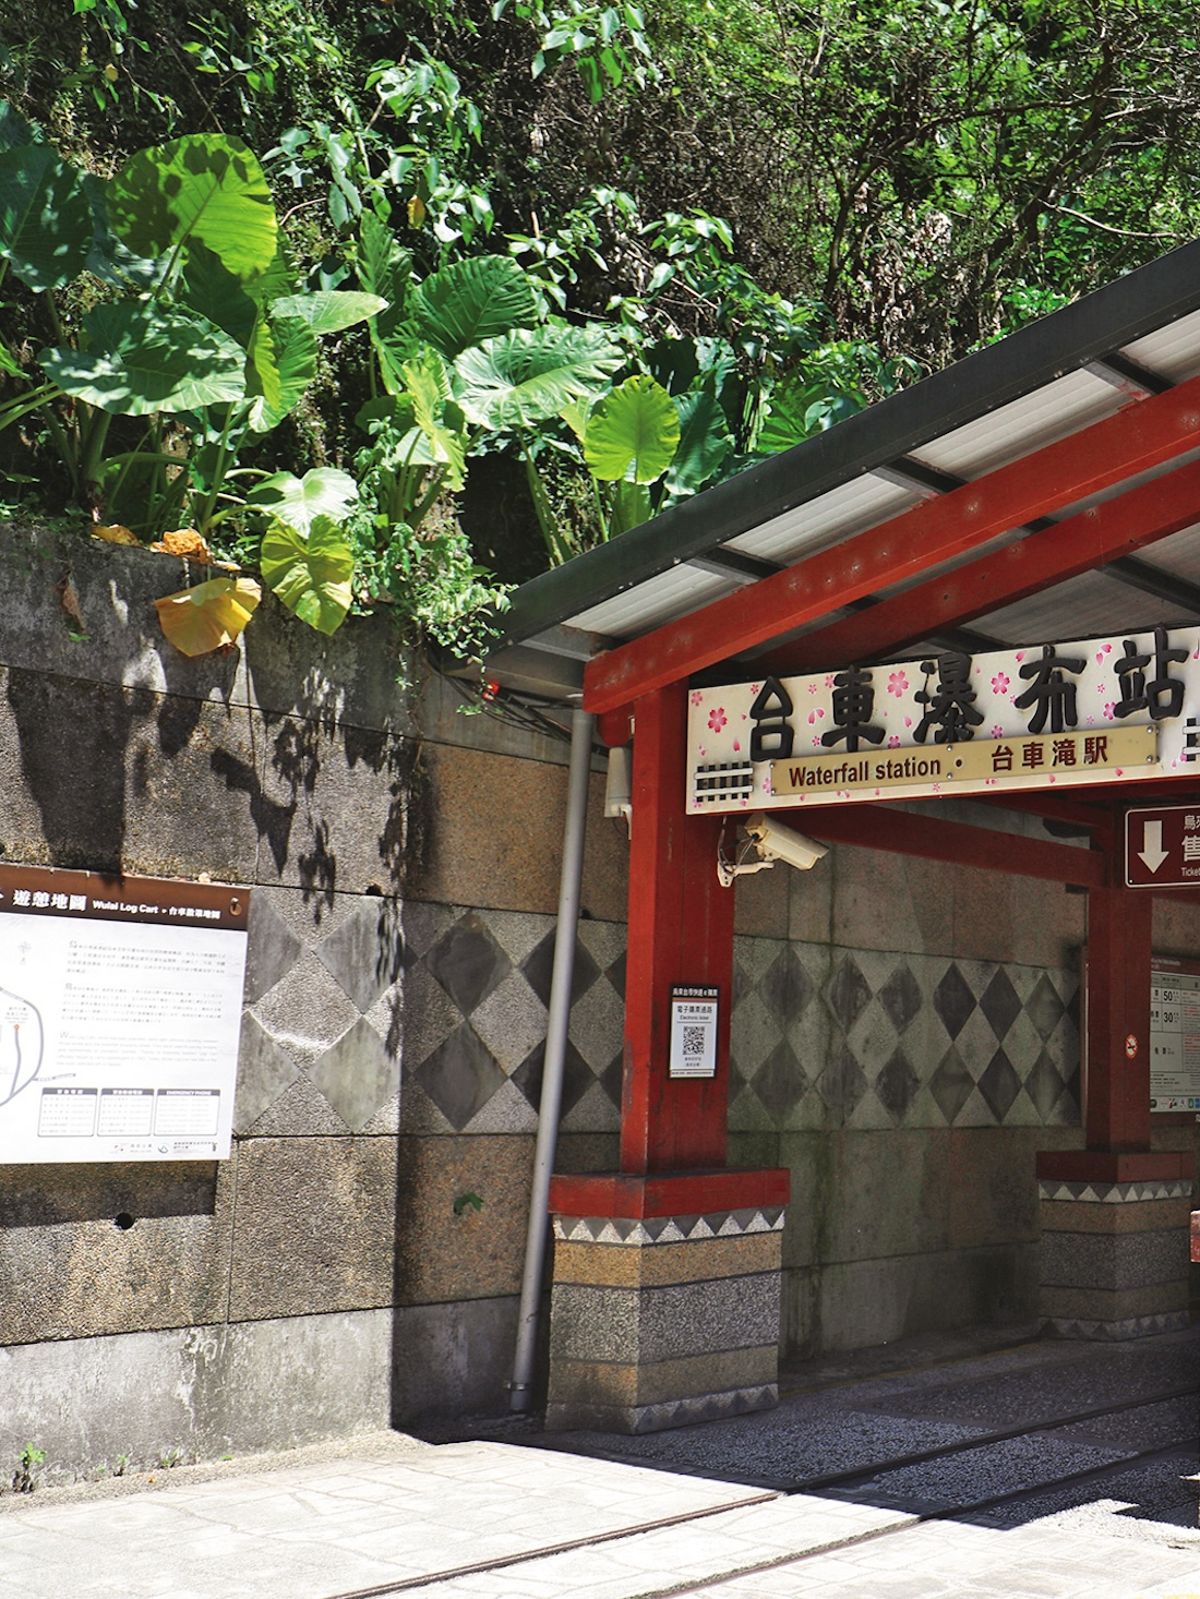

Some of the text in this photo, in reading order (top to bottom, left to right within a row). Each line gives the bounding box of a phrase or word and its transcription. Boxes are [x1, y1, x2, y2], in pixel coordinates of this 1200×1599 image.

[749, 624, 1190, 763] 台車瀑布站
[788, 734, 1109, 788] Waterfall station 台車滝駅
[1181, 866, 1200, 877] Ticket
[12, 889, 87, 911] 遊憩地圖
[92, 900, 119, 911] Wulai
[120, 902, 138, 914] Log
[139, 904, 159, 915] Cart
[1163, 990, 1173, 1001] 50
[1163, 1011, 1174, 1023] 30
